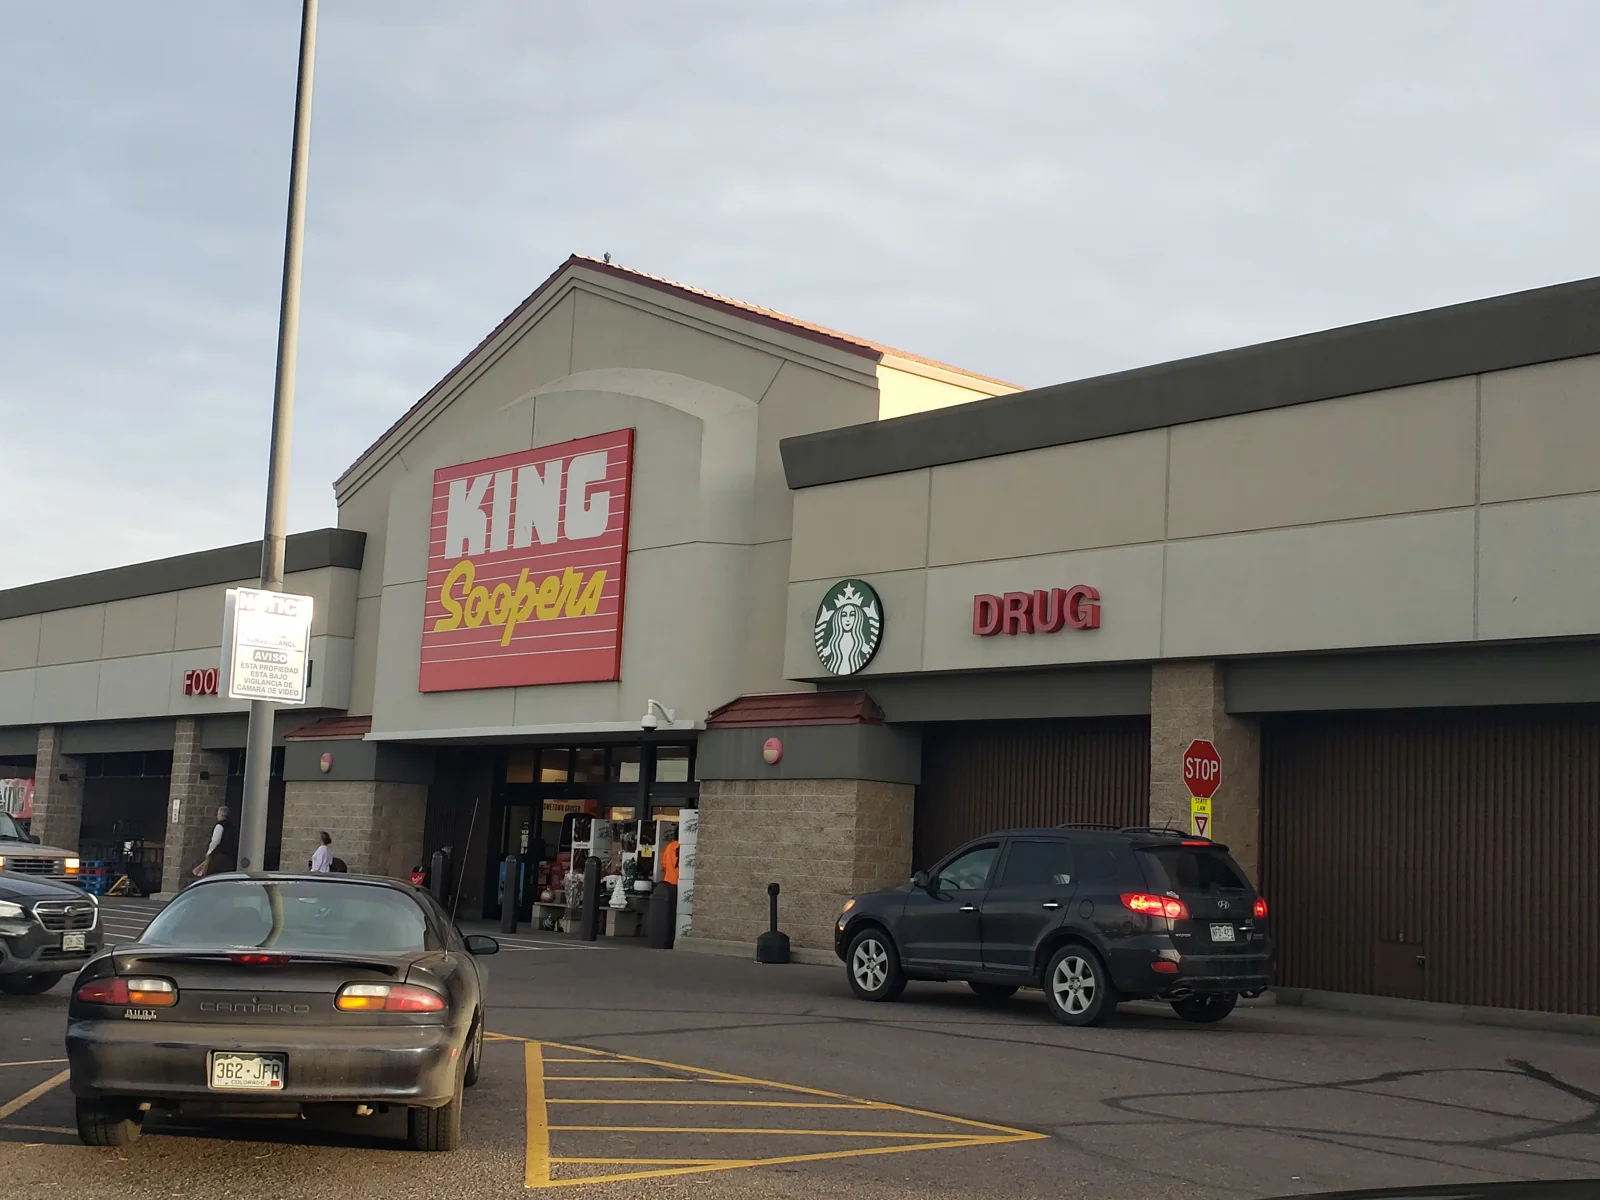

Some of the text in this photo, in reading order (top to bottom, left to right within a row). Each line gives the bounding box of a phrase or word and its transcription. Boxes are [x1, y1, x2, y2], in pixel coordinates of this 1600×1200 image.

[444, 451, 610, 559] KING
[434, 560, 607, 647] Soopers
[972, 584, 1100, 636] DRUG
[254, 651, 287, 663] AVISO
[240, 662, 299, 674] ESTA PROPIEDAD
[183, 668, 220, 696] FOO
[244, 677, 283, 687] VIGILANCIA
[250, 671, 288, 680] ESTA BAJO
[236, 684, 266, 693] CAMARA
[278, 687, 299, 696] VIDEO
[1185, 757, 1219, 781] STOP
[200, 1001, 310, 1014] CAMARO
